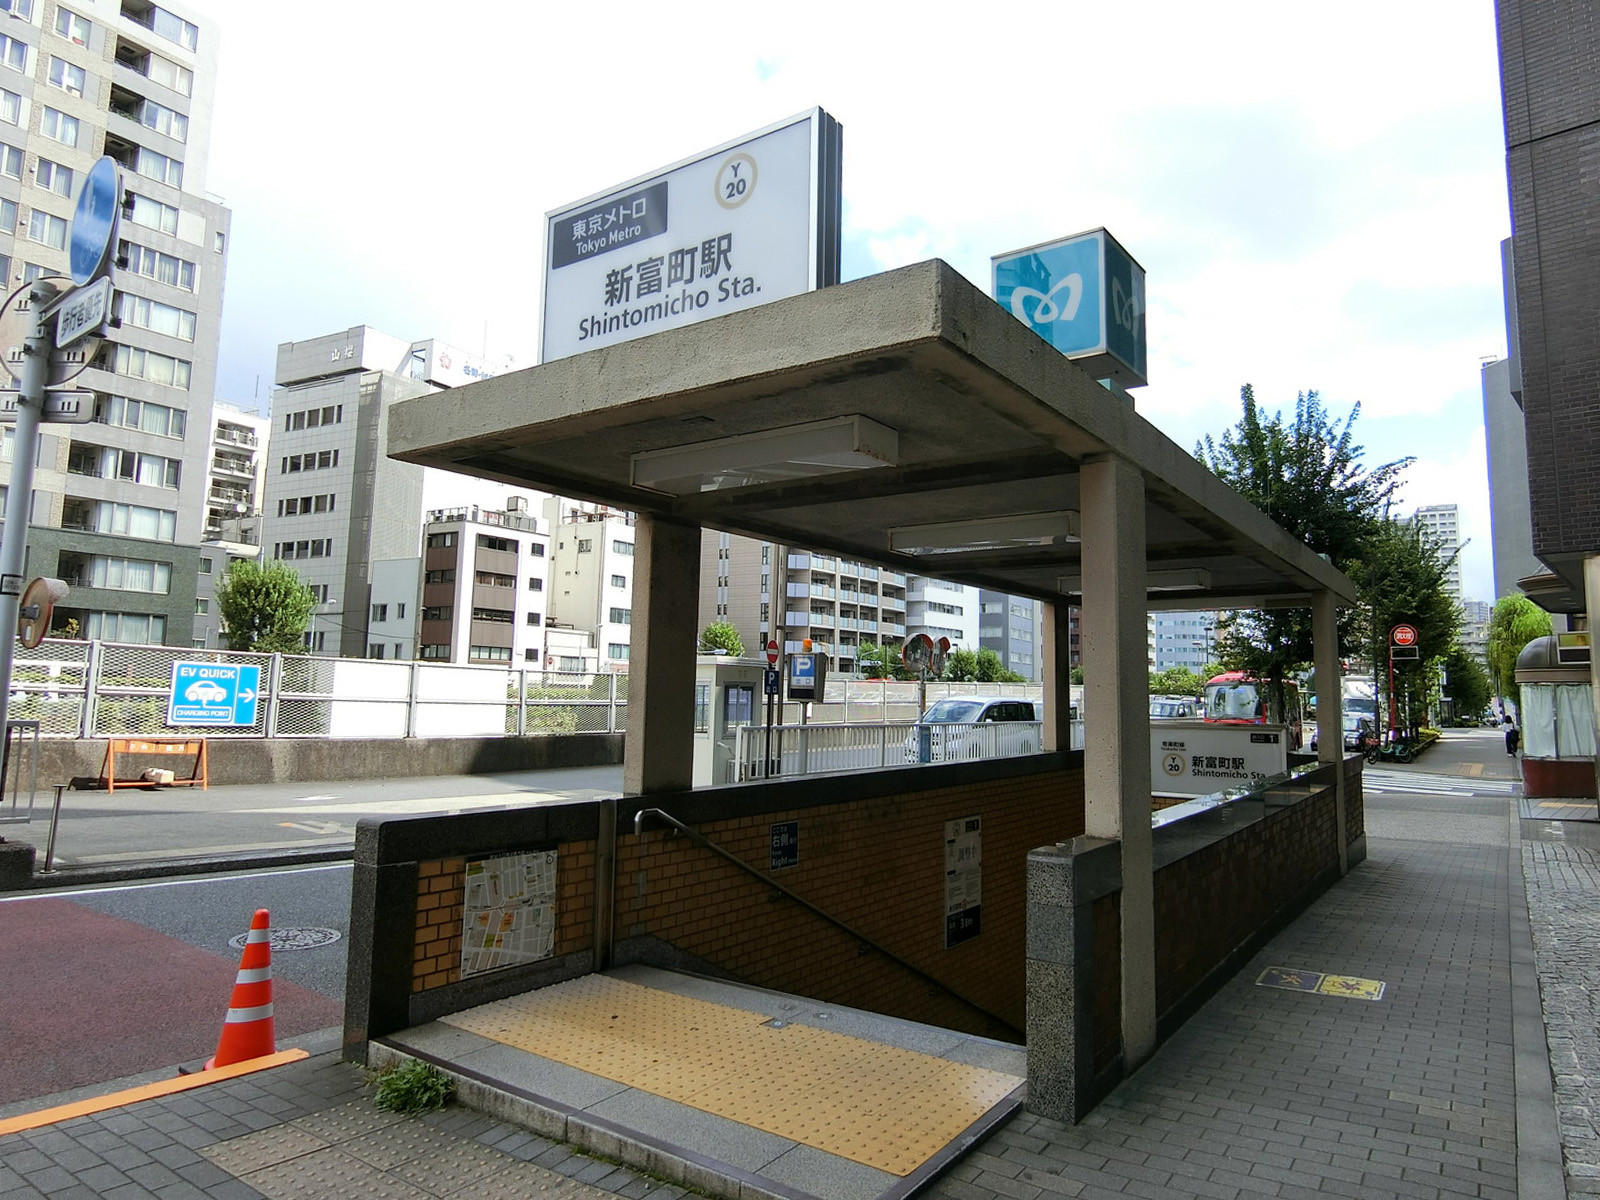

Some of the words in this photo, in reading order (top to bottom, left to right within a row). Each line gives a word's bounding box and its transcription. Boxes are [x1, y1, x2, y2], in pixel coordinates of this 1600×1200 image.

[731, 162, 741, 178] Y
[726, 178, 746, 200] 20
[572, 197, 646, 241] 東京メトロ
[576, 236, 607, 256] Tokyo
[609, 224, 641, 246] Metro
[604, 232, 733, 307] 新富町駅
[578, 289, 709, 341] Shintomicho
[717, 276, 762, 303] Sta.
[181, 667, 197, 677] EV
[199, 668, 235, 678] QUICK
[796, 658, 811, 675] P
[768, 672, 775, 684] P
[1191, 755, 1245, 770] 新富町駅
[1192, 768, 1248, 779] Shintomicho
